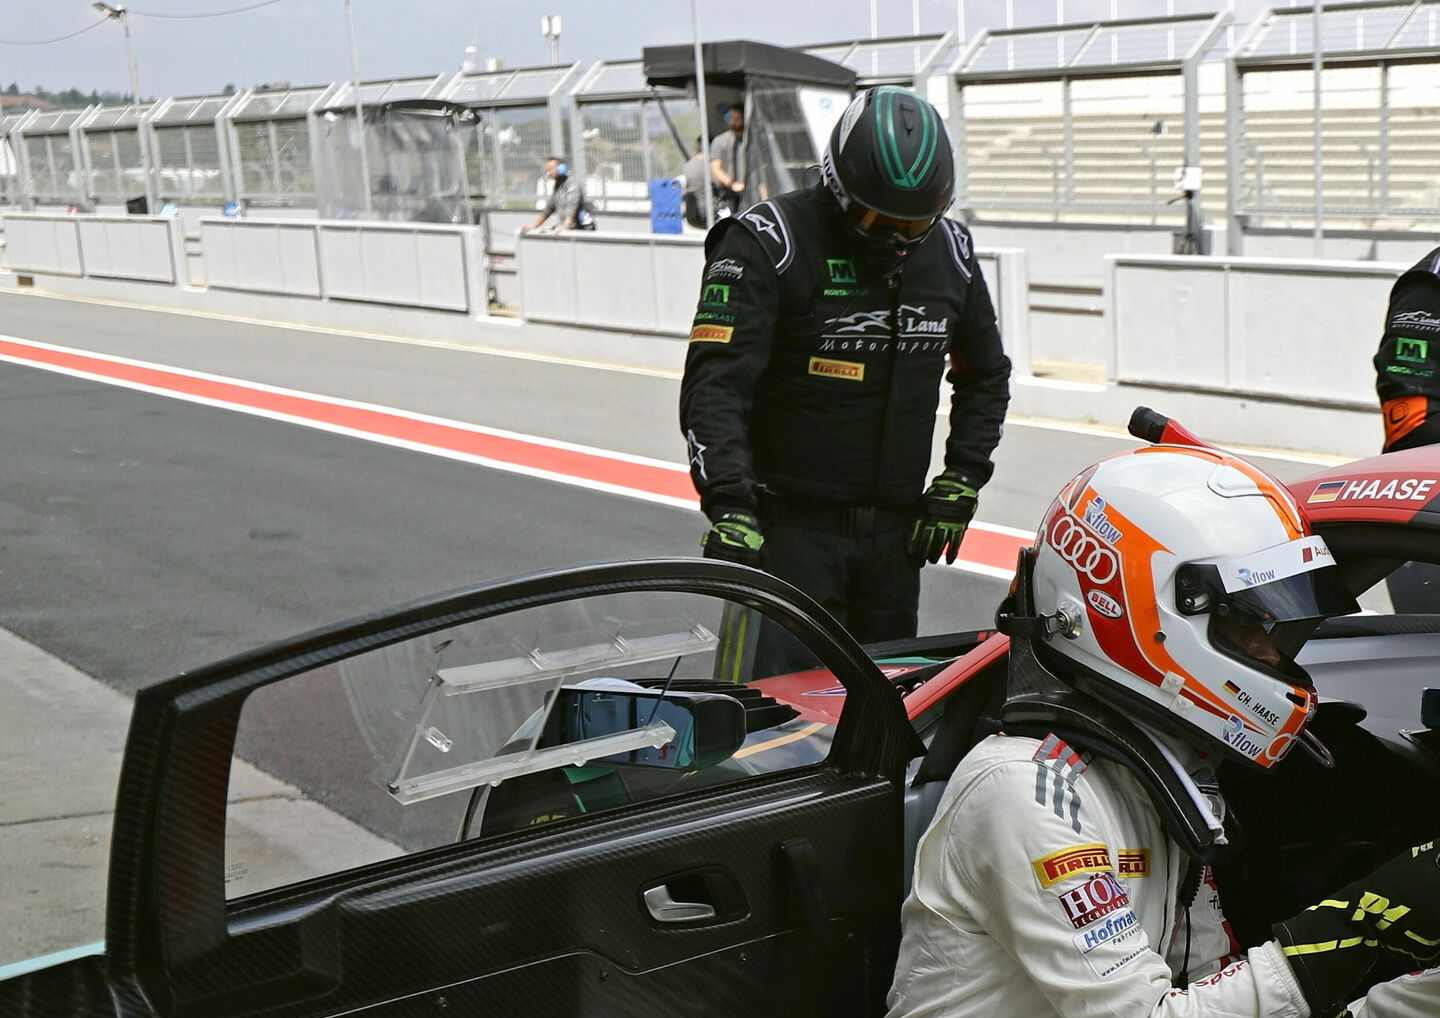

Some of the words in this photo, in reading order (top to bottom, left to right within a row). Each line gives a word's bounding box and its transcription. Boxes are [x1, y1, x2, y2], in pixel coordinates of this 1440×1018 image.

[906, 318, 948, 333] Land
[1341, 479, 1437, 502] HAASE
[1091, 592, 1119, 614] BELL
[1237, 691, 1250, 708] CH.
[1252, 702, 1280, 726] HAASE
